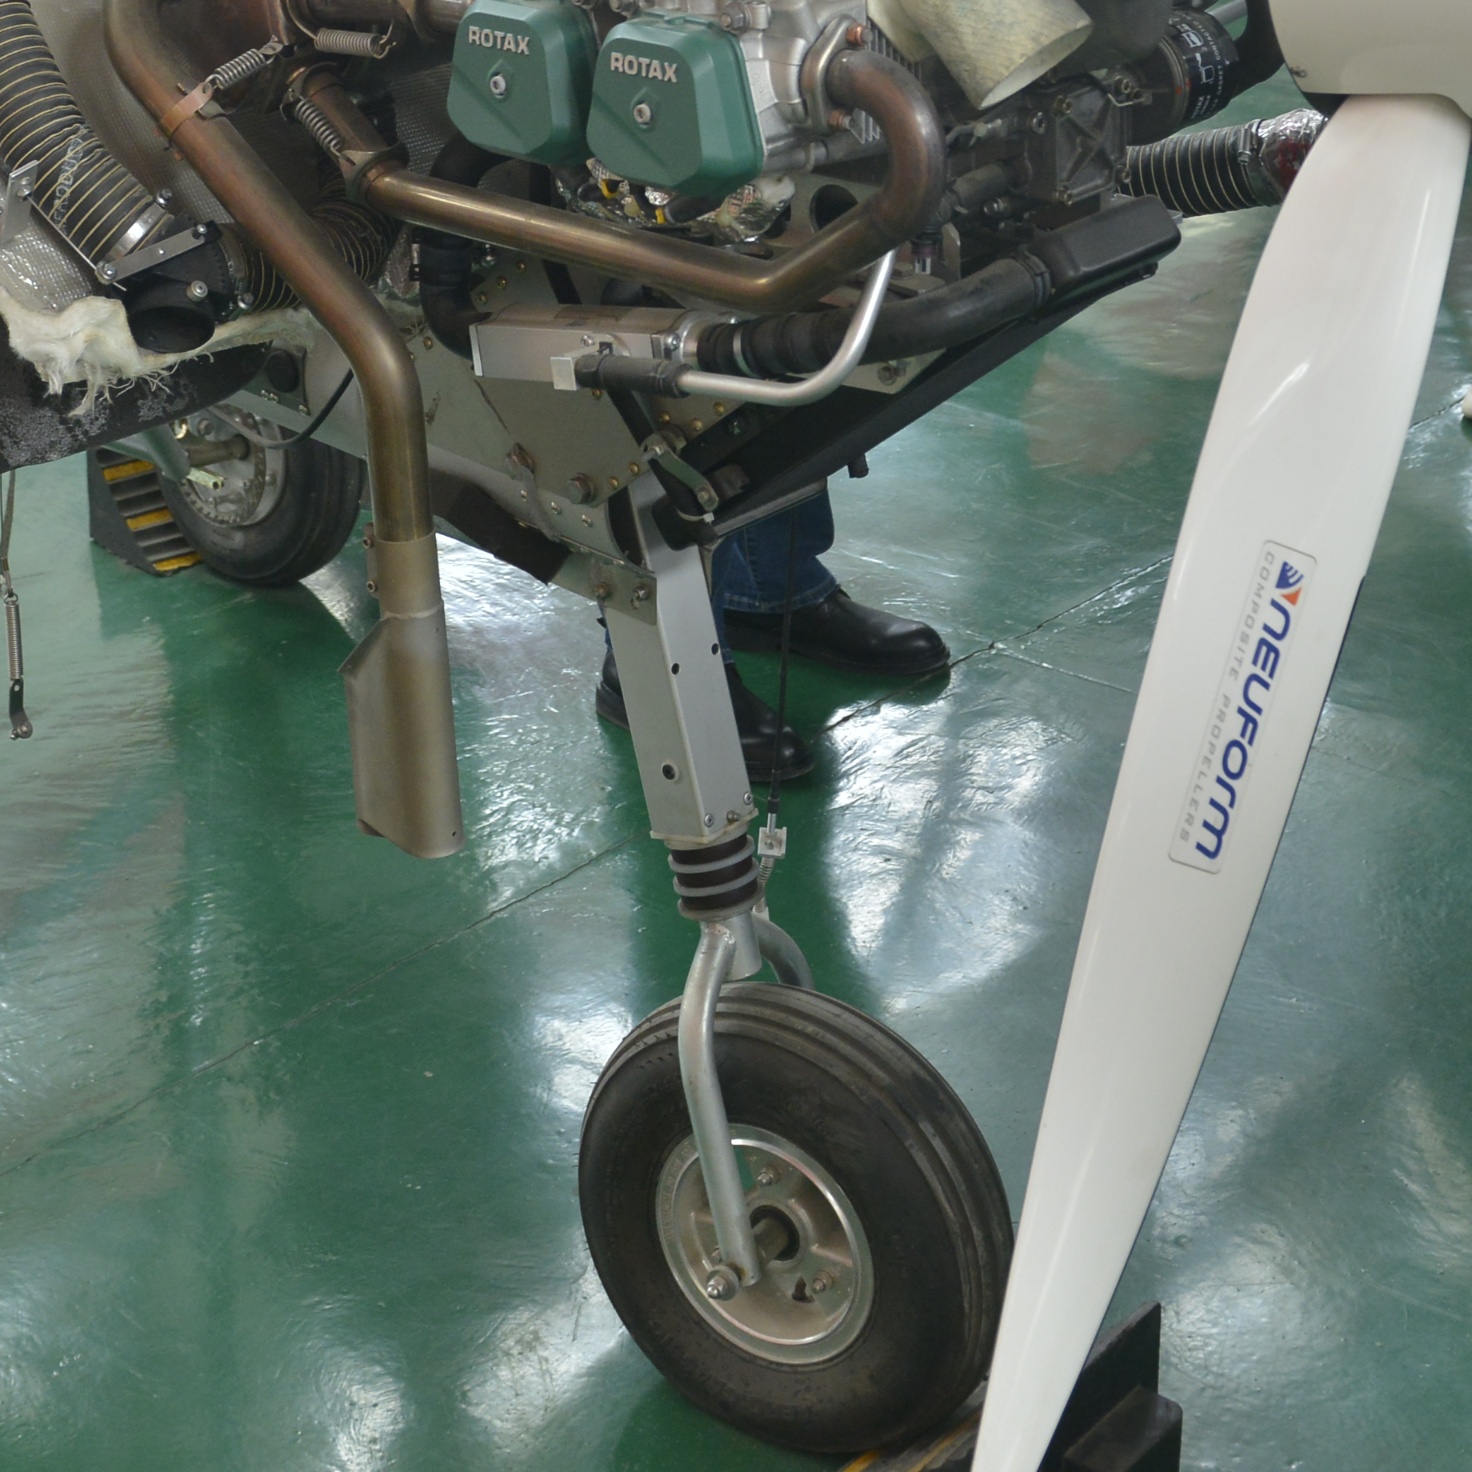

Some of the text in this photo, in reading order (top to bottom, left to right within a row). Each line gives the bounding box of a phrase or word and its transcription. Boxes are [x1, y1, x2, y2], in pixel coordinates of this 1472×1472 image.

[468, 25, 530, 55] ROTAX
[609, 51, 678, 83] ROTAX
[1179, 551, 1276, 843] COMPOSITE PROPELLERS
